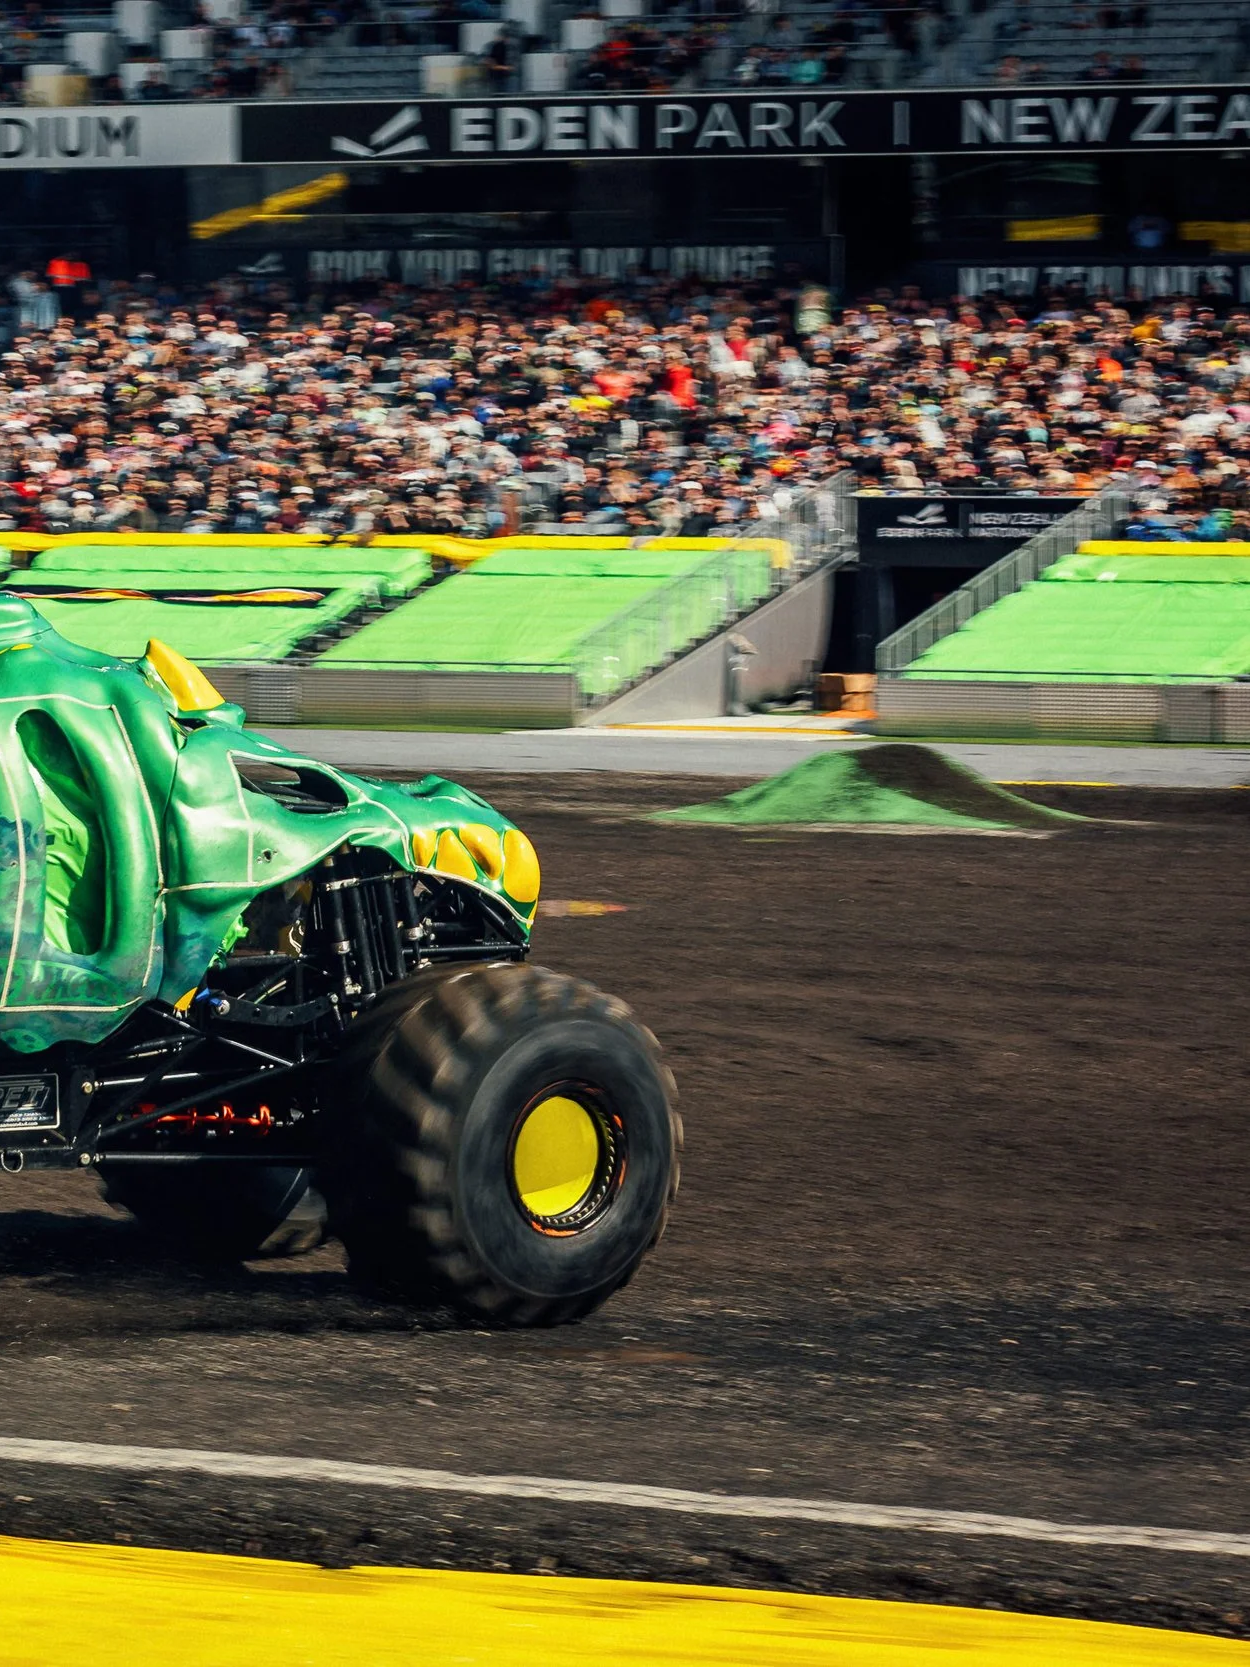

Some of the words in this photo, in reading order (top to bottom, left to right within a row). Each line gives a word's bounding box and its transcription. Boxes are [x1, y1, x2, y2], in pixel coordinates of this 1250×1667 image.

[450, 104, 640, 152] EDEN
[654, 100, 847, 149] PARK
[959, 97, 1121, 144] NEW
